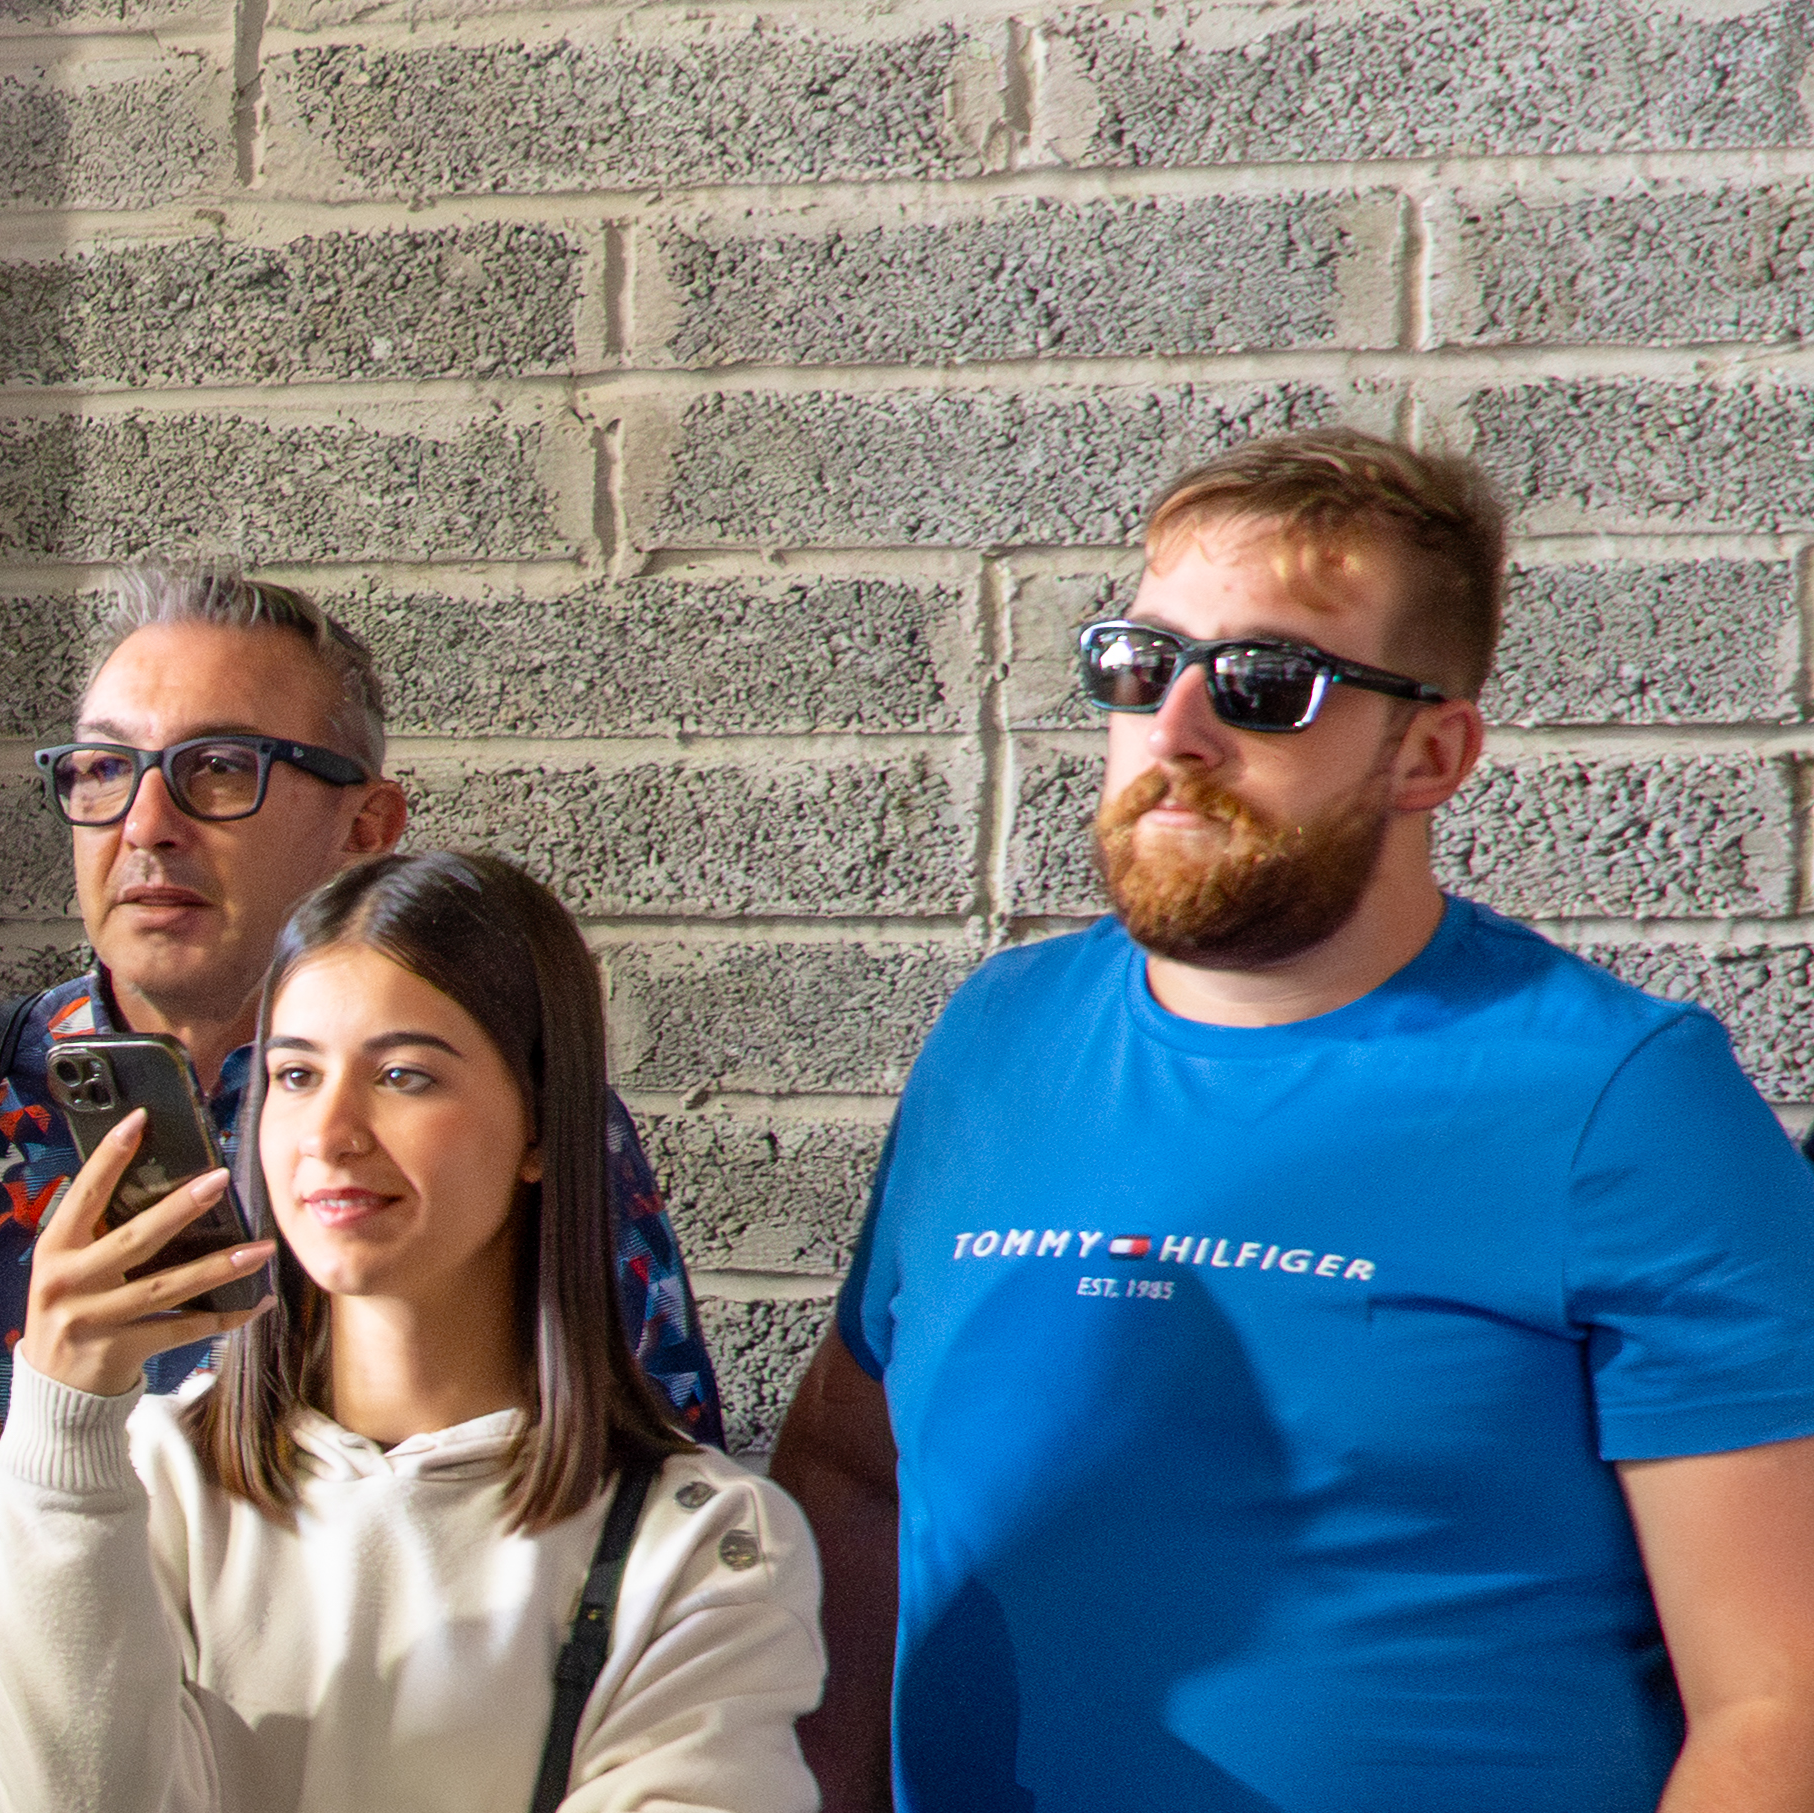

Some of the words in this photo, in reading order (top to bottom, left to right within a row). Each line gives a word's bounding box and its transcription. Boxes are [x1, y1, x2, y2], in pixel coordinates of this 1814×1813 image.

[952, 1230, 1104, 1261] TOMMY
[1158, 1234, 1377, 1281] HILFIGER
[1076, 1276, 1119, 1297] EST.
[1125, 1279, 1175, 1301] 1985
